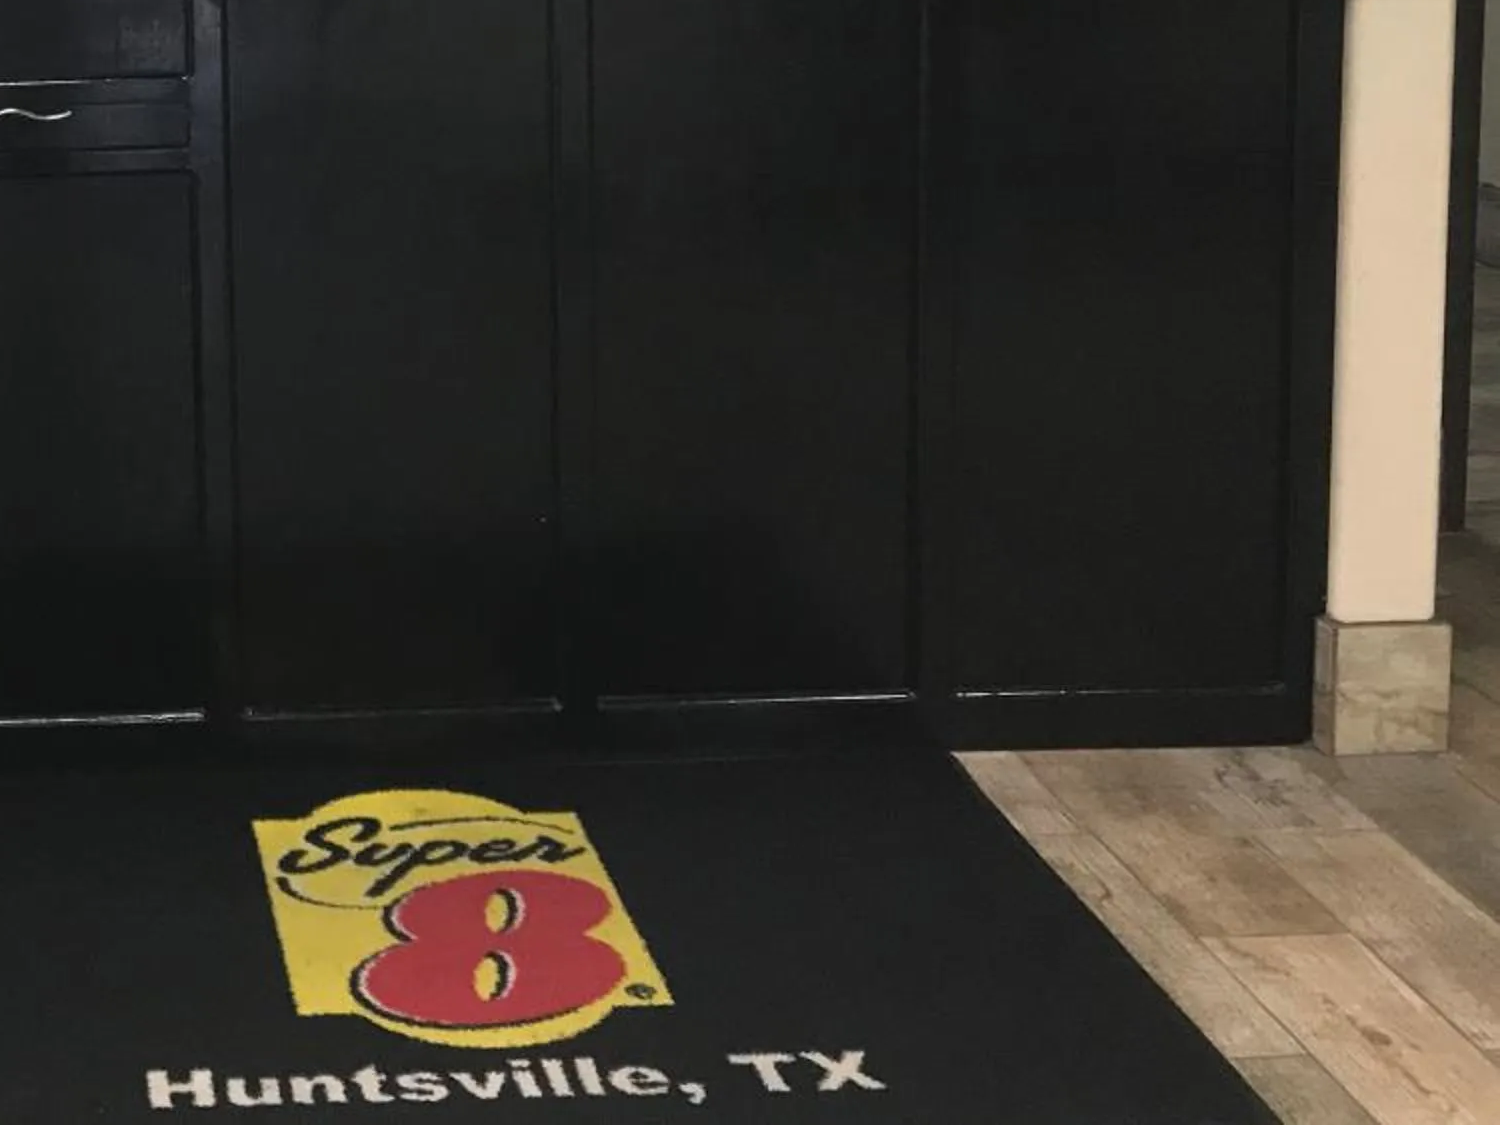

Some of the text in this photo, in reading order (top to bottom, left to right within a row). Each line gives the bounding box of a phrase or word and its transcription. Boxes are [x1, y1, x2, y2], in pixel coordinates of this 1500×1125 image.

[279, 817, 588, 897] Super
[349, 869, 628, 1030] 8
[145, 1050, 888, 1109] Huntsville, TX
